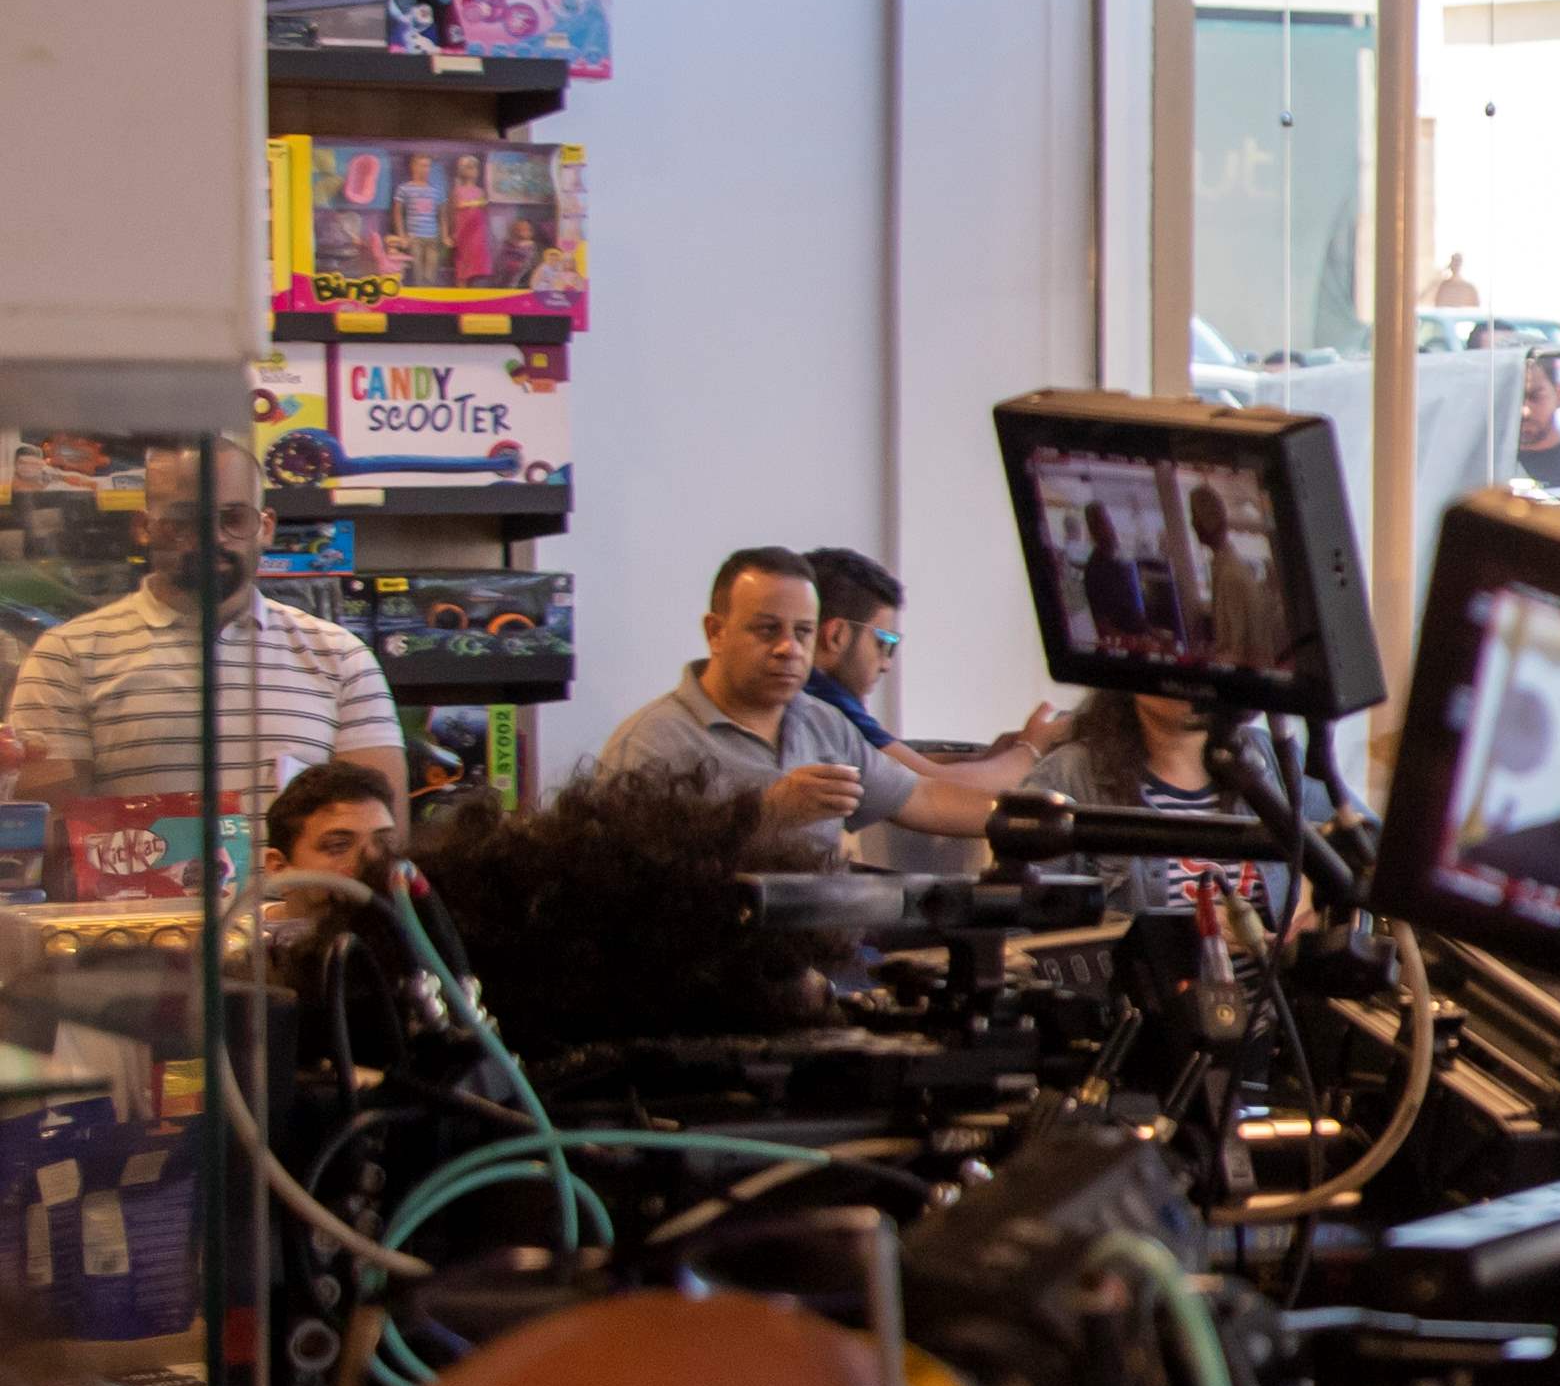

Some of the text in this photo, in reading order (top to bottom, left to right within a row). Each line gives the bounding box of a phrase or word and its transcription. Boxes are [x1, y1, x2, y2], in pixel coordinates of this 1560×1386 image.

[313, 274, 401, 305] Bingo
[351, 365, 453, 401] CANDY
[368, 393, 512, 434] SCOOTER
